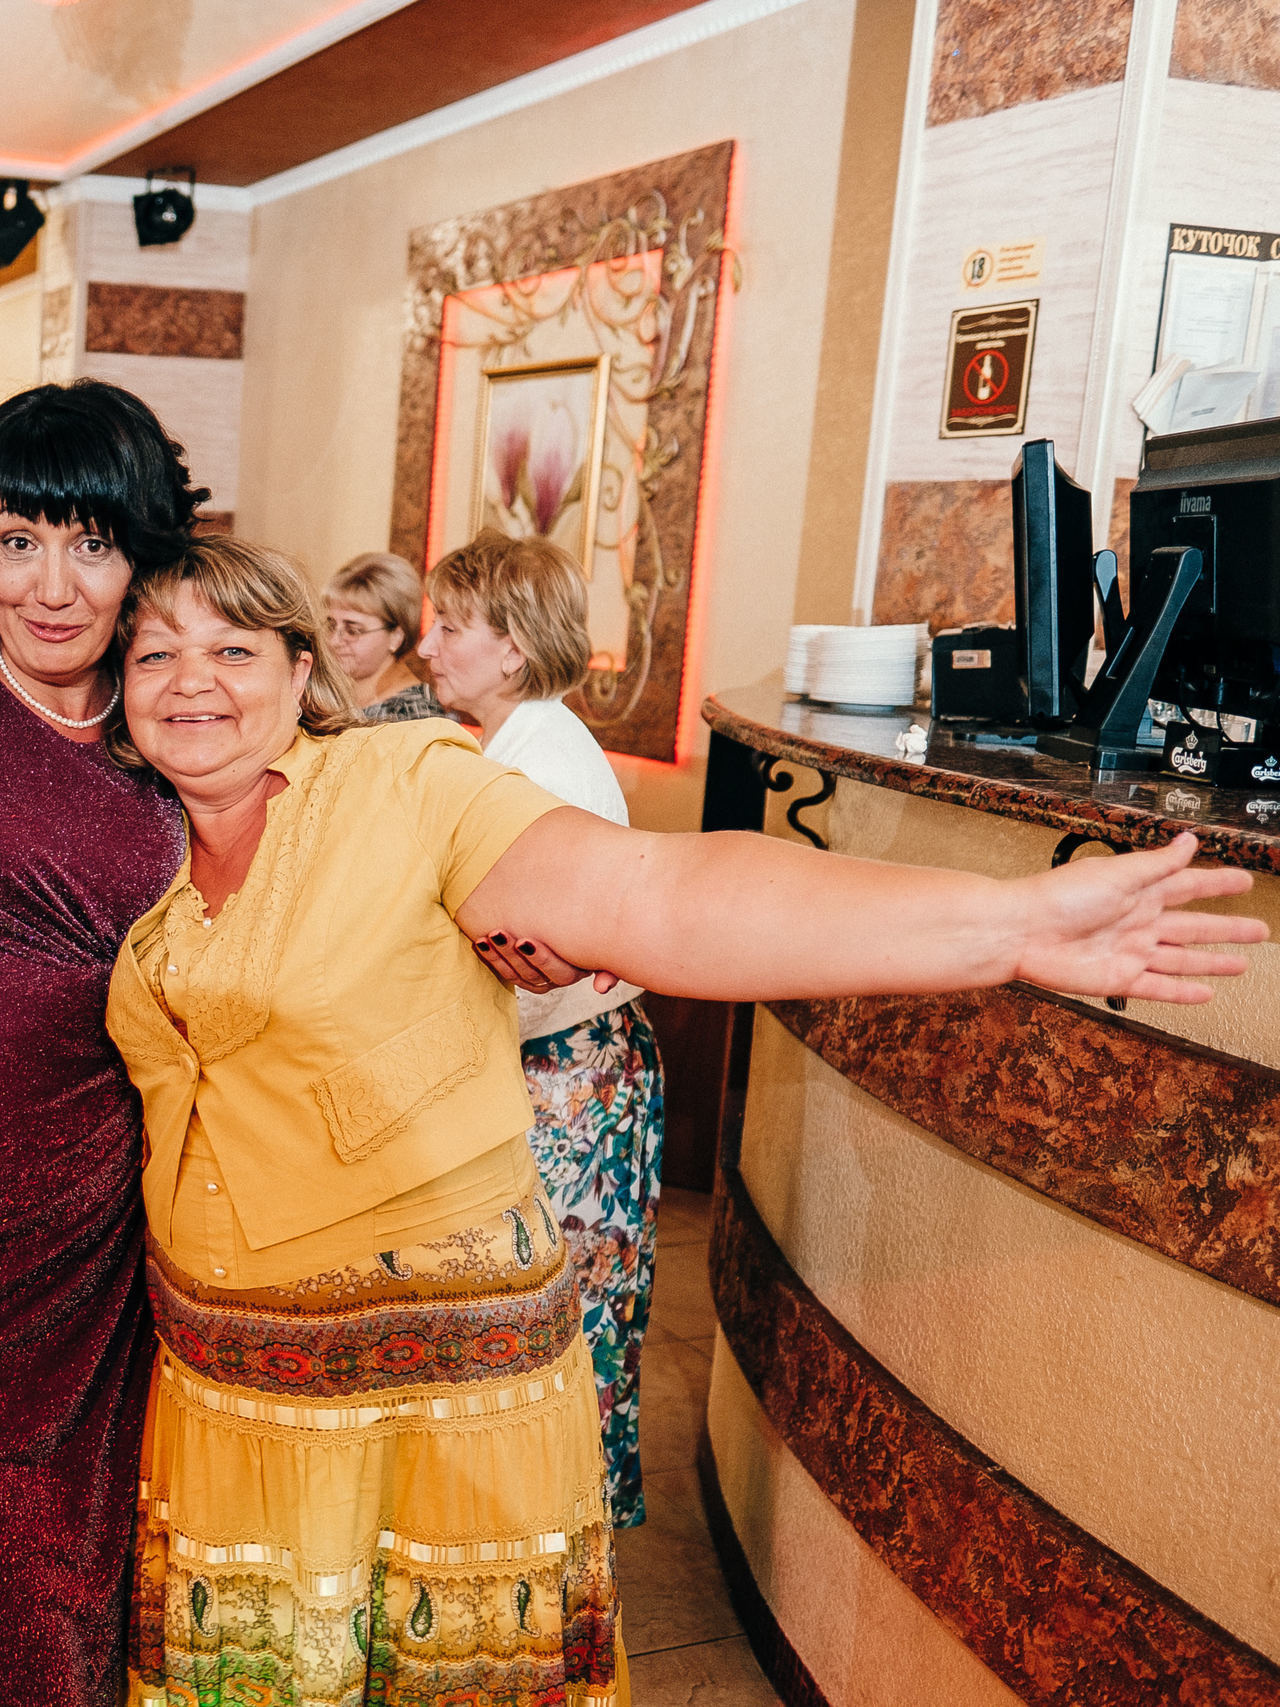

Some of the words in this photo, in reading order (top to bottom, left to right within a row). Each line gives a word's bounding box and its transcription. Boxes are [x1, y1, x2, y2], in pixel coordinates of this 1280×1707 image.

[1170, 227, 1261, 258] КУТОЧОК
[971, 257, 985, 280] 18
[1180, 492, 1211, 513] iiyama
[1171, 747, 1207, 775] Carlsberg
[1251, 766, 1280, 781] Carlsbe
